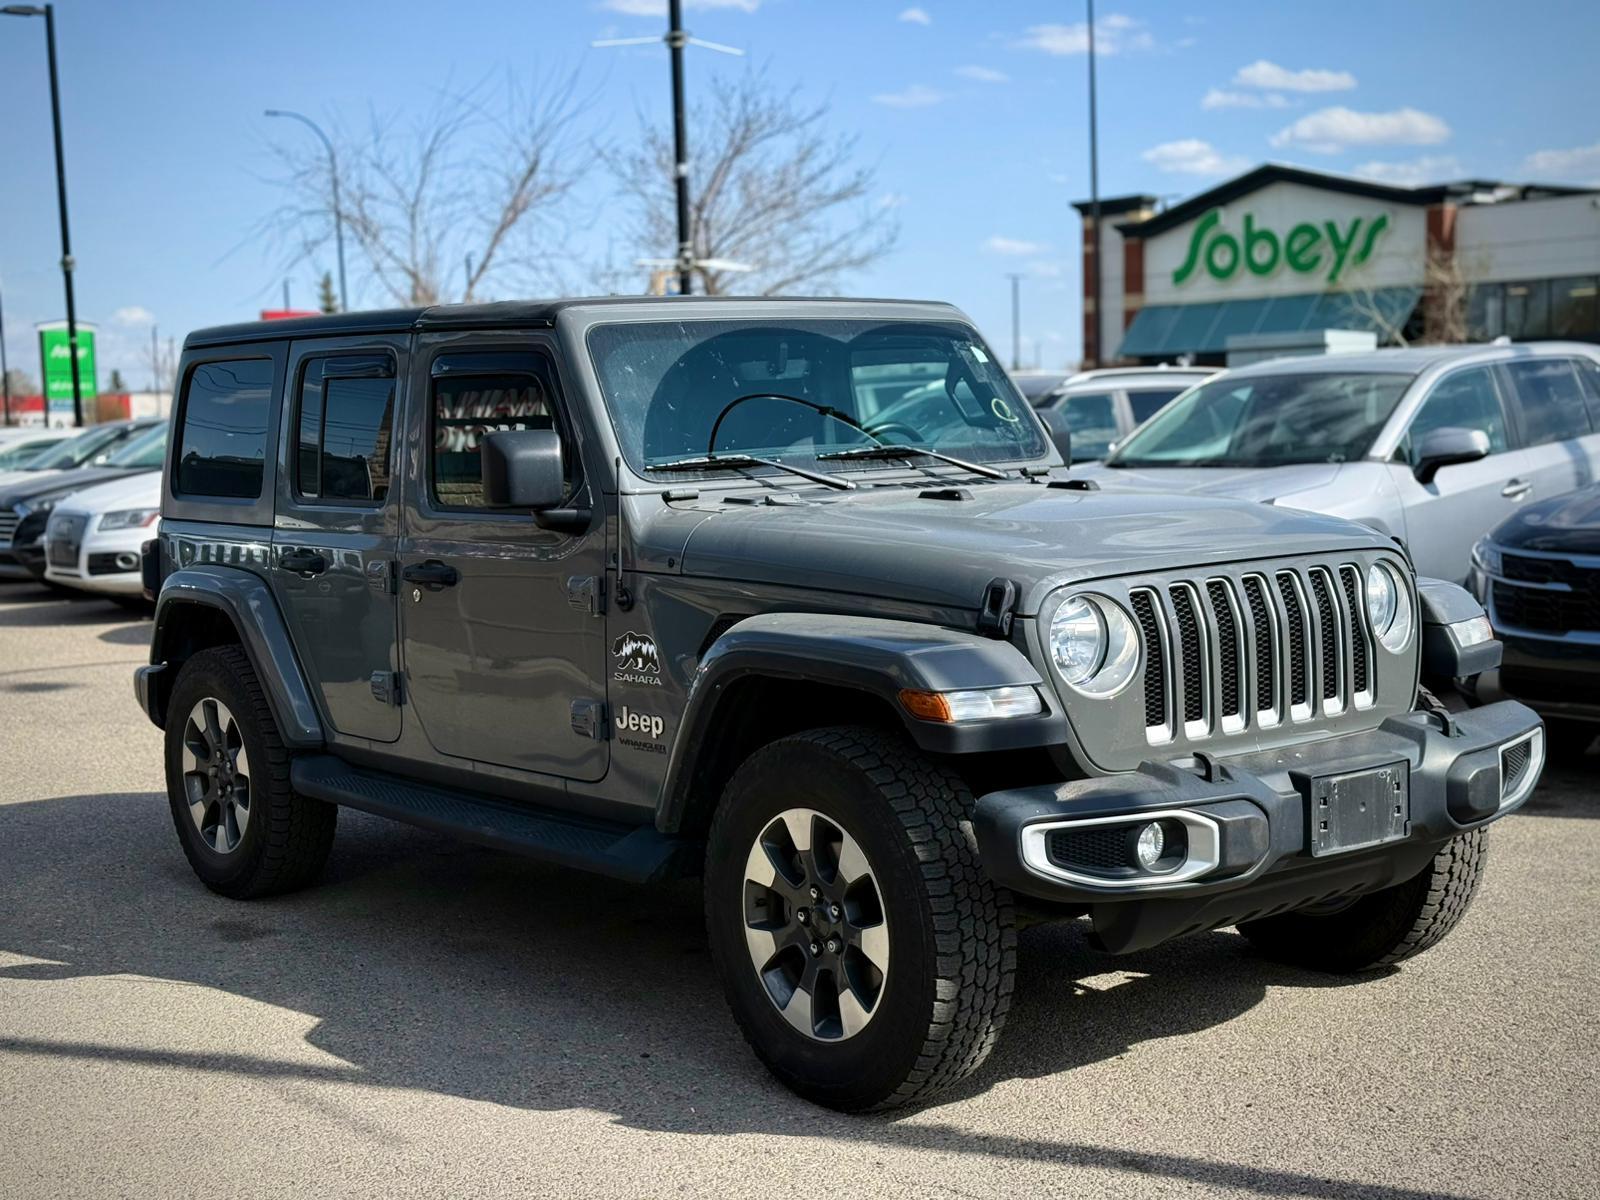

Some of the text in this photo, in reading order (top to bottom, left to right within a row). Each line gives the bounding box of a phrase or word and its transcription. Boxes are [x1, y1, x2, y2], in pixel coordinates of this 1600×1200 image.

[1173, 209, 1388, 285] Sobeys
[614, 672, 662, 686] SAHARA
[615, 706, 664, 738] Jeep
